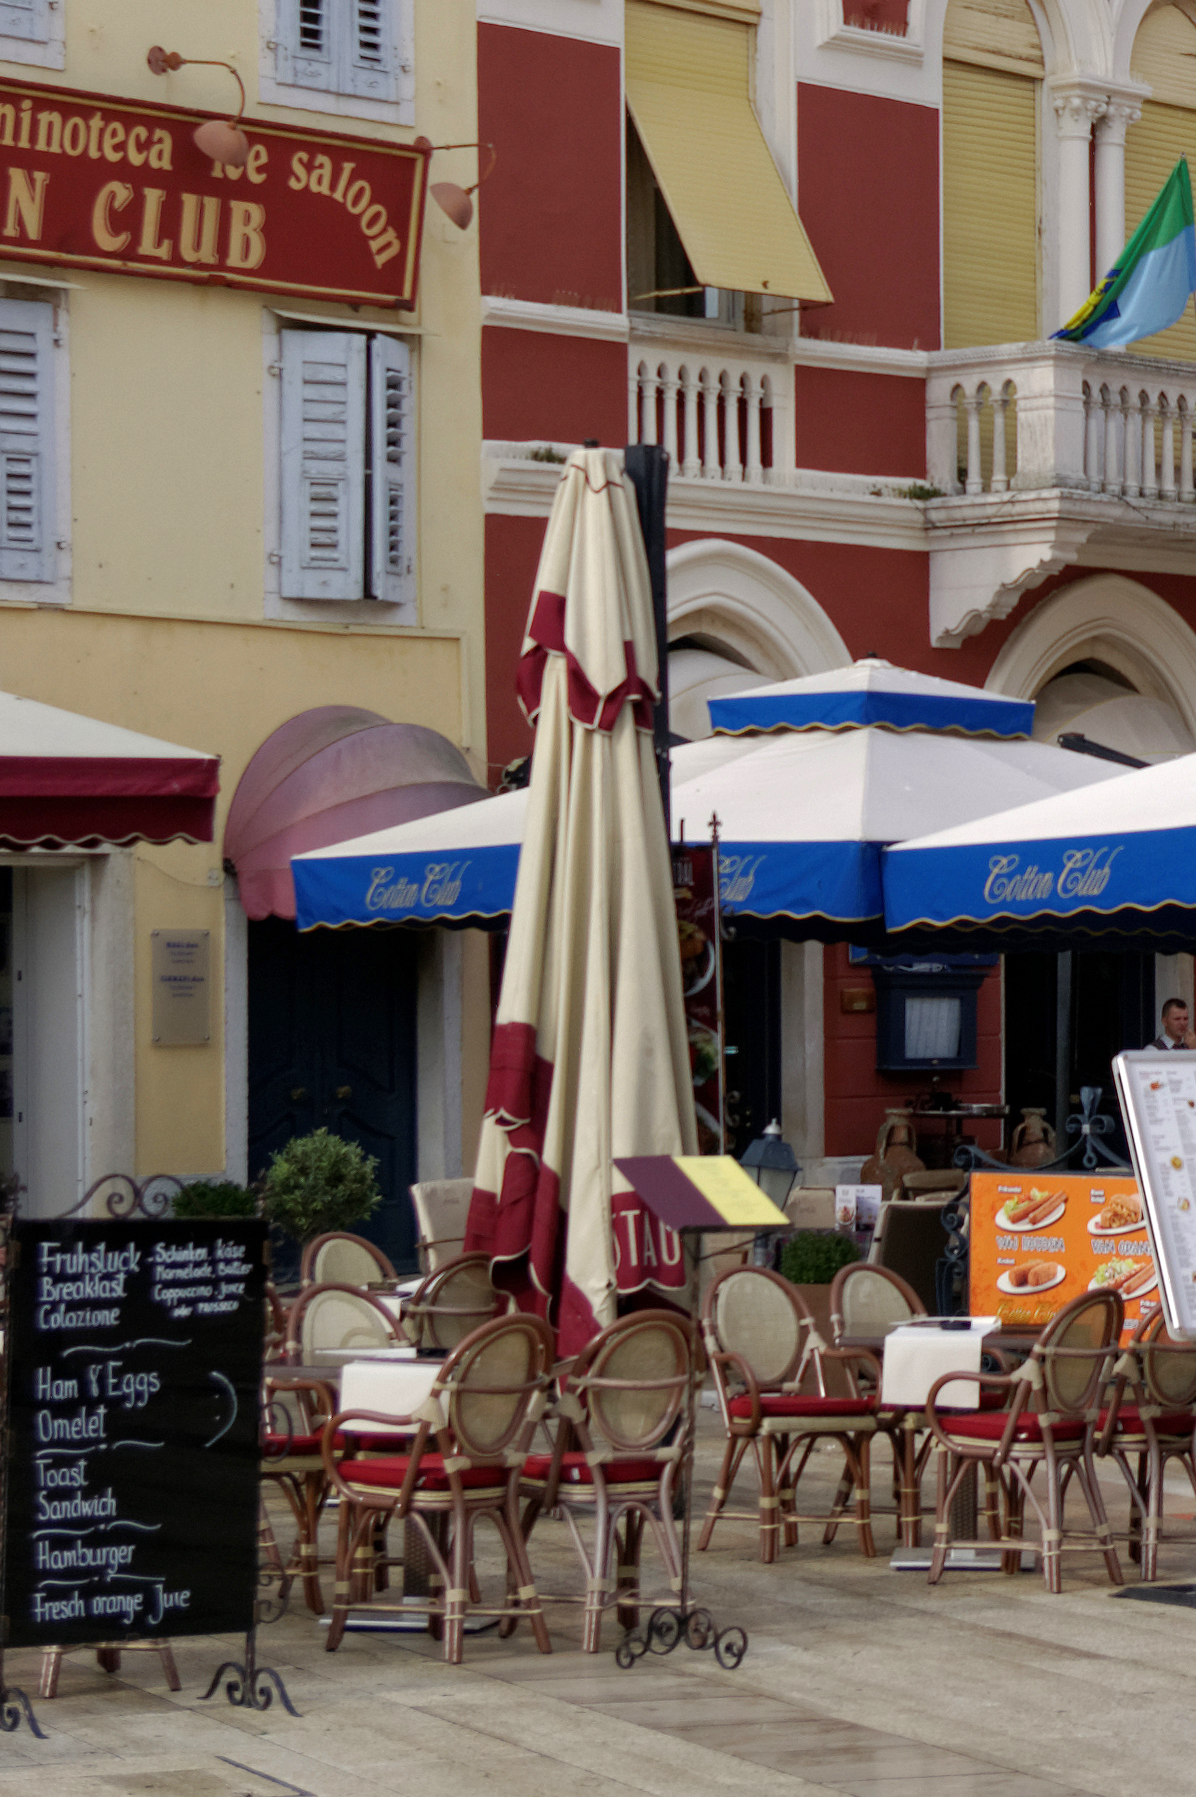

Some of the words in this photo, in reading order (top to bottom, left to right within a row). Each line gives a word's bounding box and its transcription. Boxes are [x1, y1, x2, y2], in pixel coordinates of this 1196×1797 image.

[92, 180, 267, 269] CLUB
[288, 150, 402, 269] saloon
[365, 866, 419, 911] Cotton
[421, 860, 472, 907] Club
[984, 854, 1053, 903] Cotton
[1057, 845, 1124, 898] Club
[40, 1273, 127, 1301] Breakfast
[39, 1304, 121, 1329] Colazione
[37, 1366, 79, 1400] Ham
[107, 1361, 161, 1408] Eggs
[38, 1404, 107, 1442] Omelet
[35, 1459, 89, 1487] Toast
[38, 1487, 117, 1520] Sandwich
[38, 1540, 136, 1574] Hamburger
[33, 1591, 85, 1622] Fresch
[92, 1593, 144, 1624] orange
